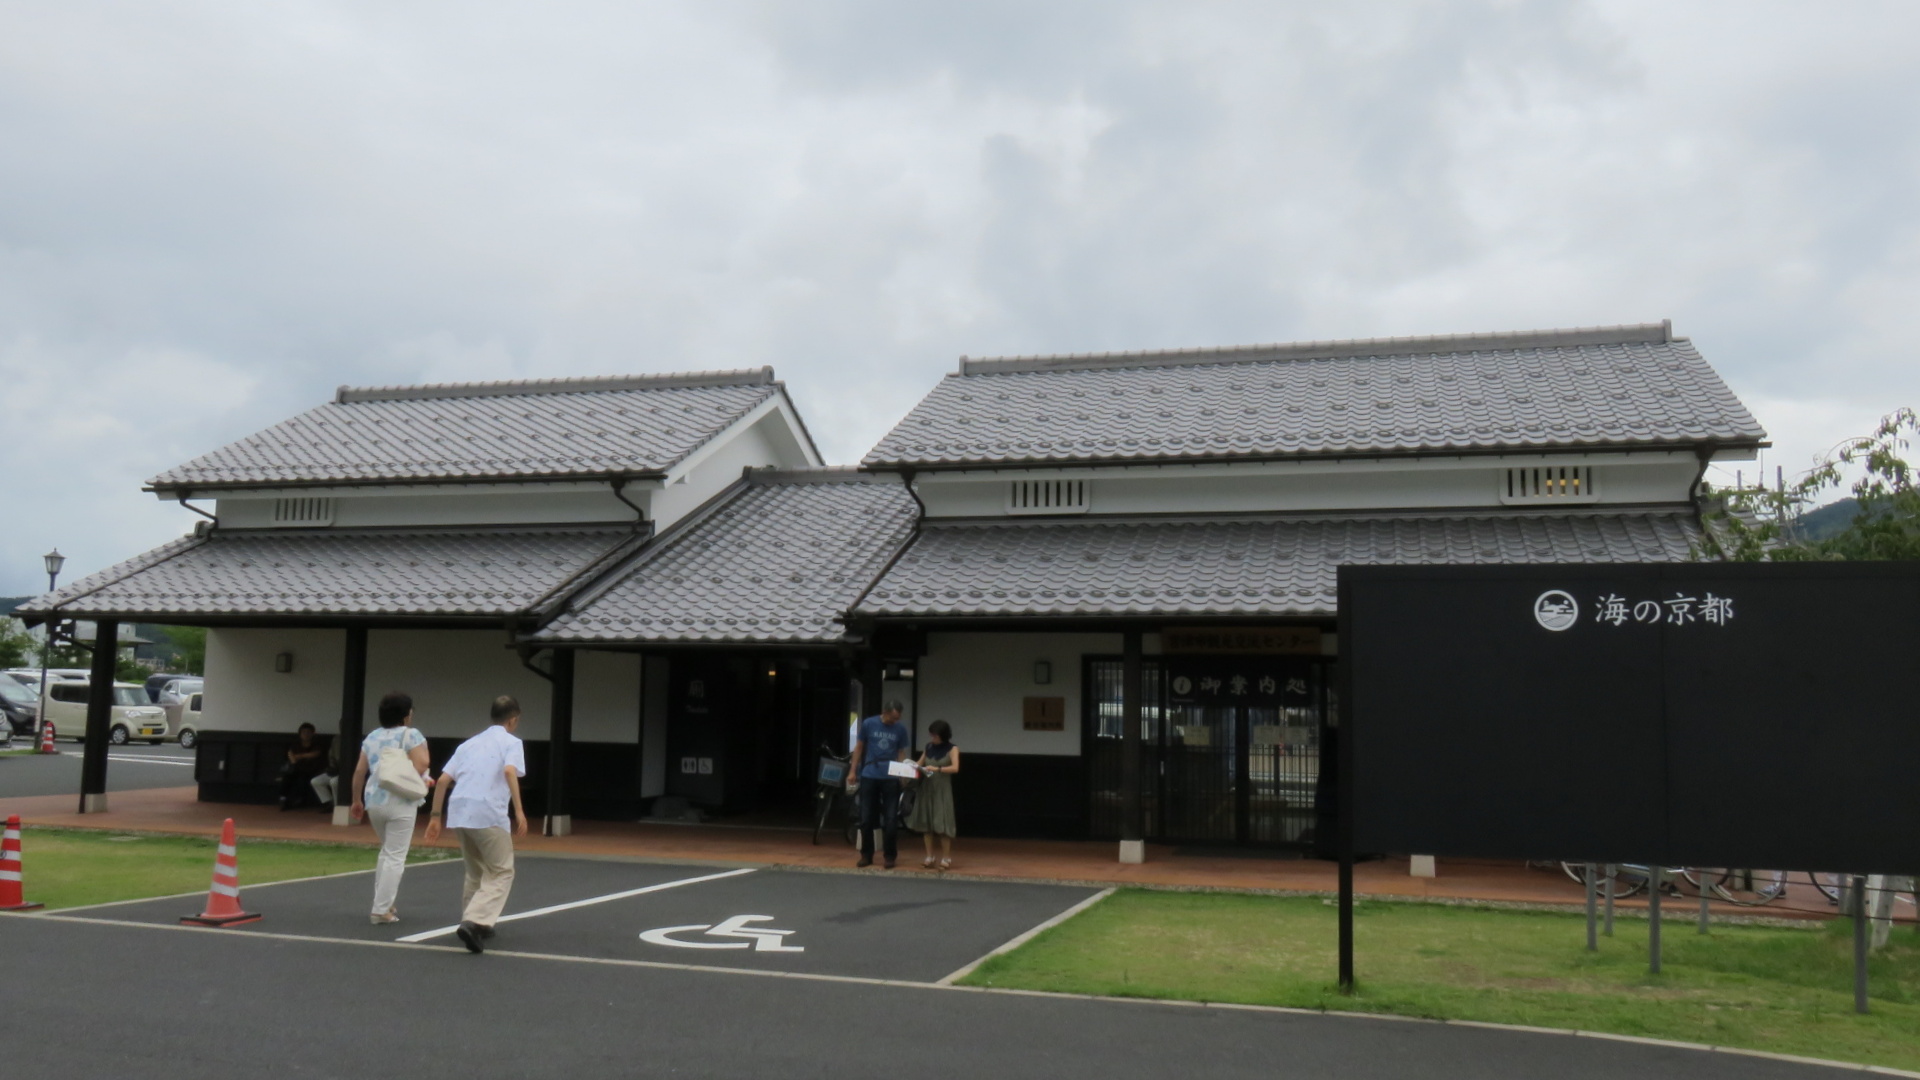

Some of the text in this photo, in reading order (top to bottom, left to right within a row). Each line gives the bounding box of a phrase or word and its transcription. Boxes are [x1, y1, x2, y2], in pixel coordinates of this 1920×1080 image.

[1595, 592, 1734, 627] 海の京都
[1200, 674, 1307, 696] 御案内処
